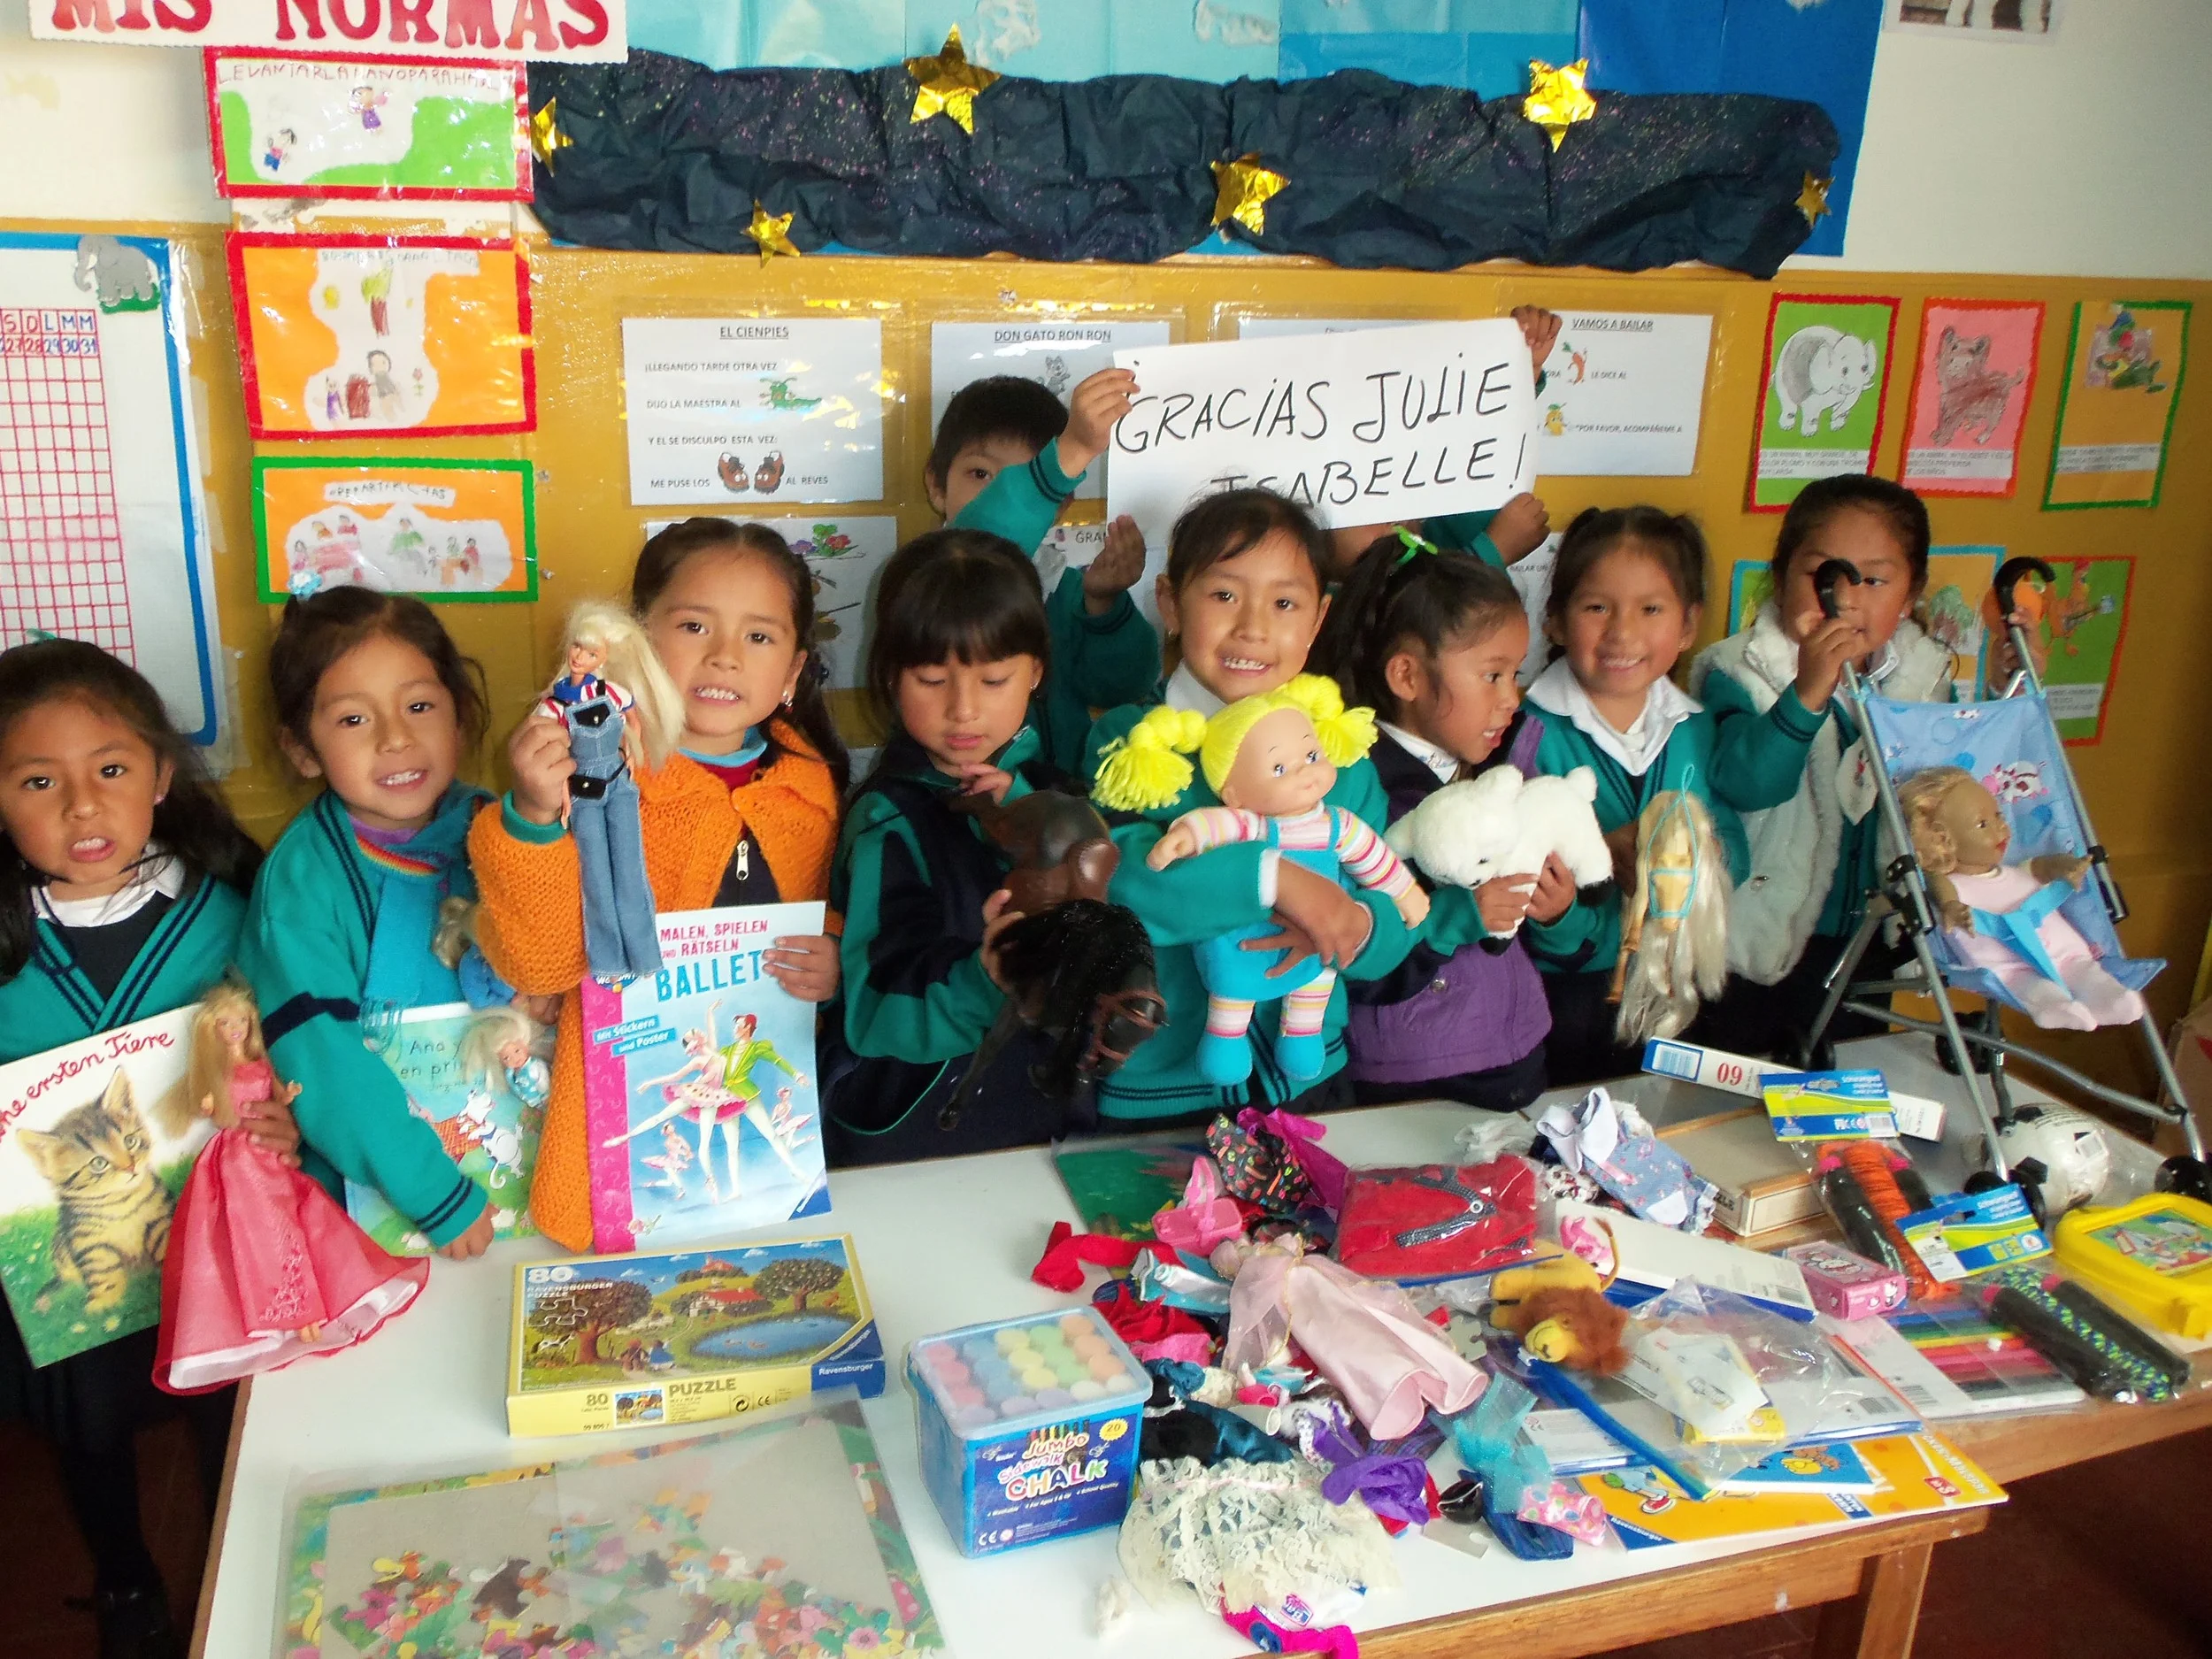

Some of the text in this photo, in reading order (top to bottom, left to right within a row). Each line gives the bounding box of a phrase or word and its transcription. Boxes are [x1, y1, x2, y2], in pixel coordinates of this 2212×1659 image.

[275, 0, 609, 50] NORMAS
[1571, 319, 1654, 331] VAMOS A BAILAR
[719, 326, 789, 338] EL CIENPIES
[995, 330, 1111, 342] DON GATO RON RON
[701, 363, 729, 372] TARDE
[733, 363, 758, 372] OTRA
[760, 362, 778, 371] VEZ
[670, 400, 681, 409] LA
[683, 399, 727, 409] MAESTRA
[730, 399, 741, 408] AL
[648, 436, 655, 445] Y
[657, 436, 666, 445] EL
[668, 436, 680, 445] SE
[731, 435, 754, 444] ESTA
[650, 480, 664, 488] ME
[693, 479, 710, 488] LOS
[801, 476, 829, 485] REVES
[660, 920, 768, 942] MALEN, SPIELEN
[681, 938, 739, 956] RÄTSELN
[656, 950, 763, 1002] BALLET
[613, 1018, 656, 1037] Stickern
[636, 1032, 669, 1048] Poster
[410, 1041, 445, 1056] Ana
[27, 1053, 105, 1099] ersten
[104, 1031, 175, 1059] Tiere
[401, 1066, 421, 1079] en
[528, 1266, 574, 1284] 80
[818, 1363, 873, 1376] Ravensburger
[669, 1378, 737, 1397] PUZZLE
[586, 1393, 609, 1406] 80
[1107, 1423, 1121, 1432] 20
[1005, 1459, 1109, 1502] CHALK
